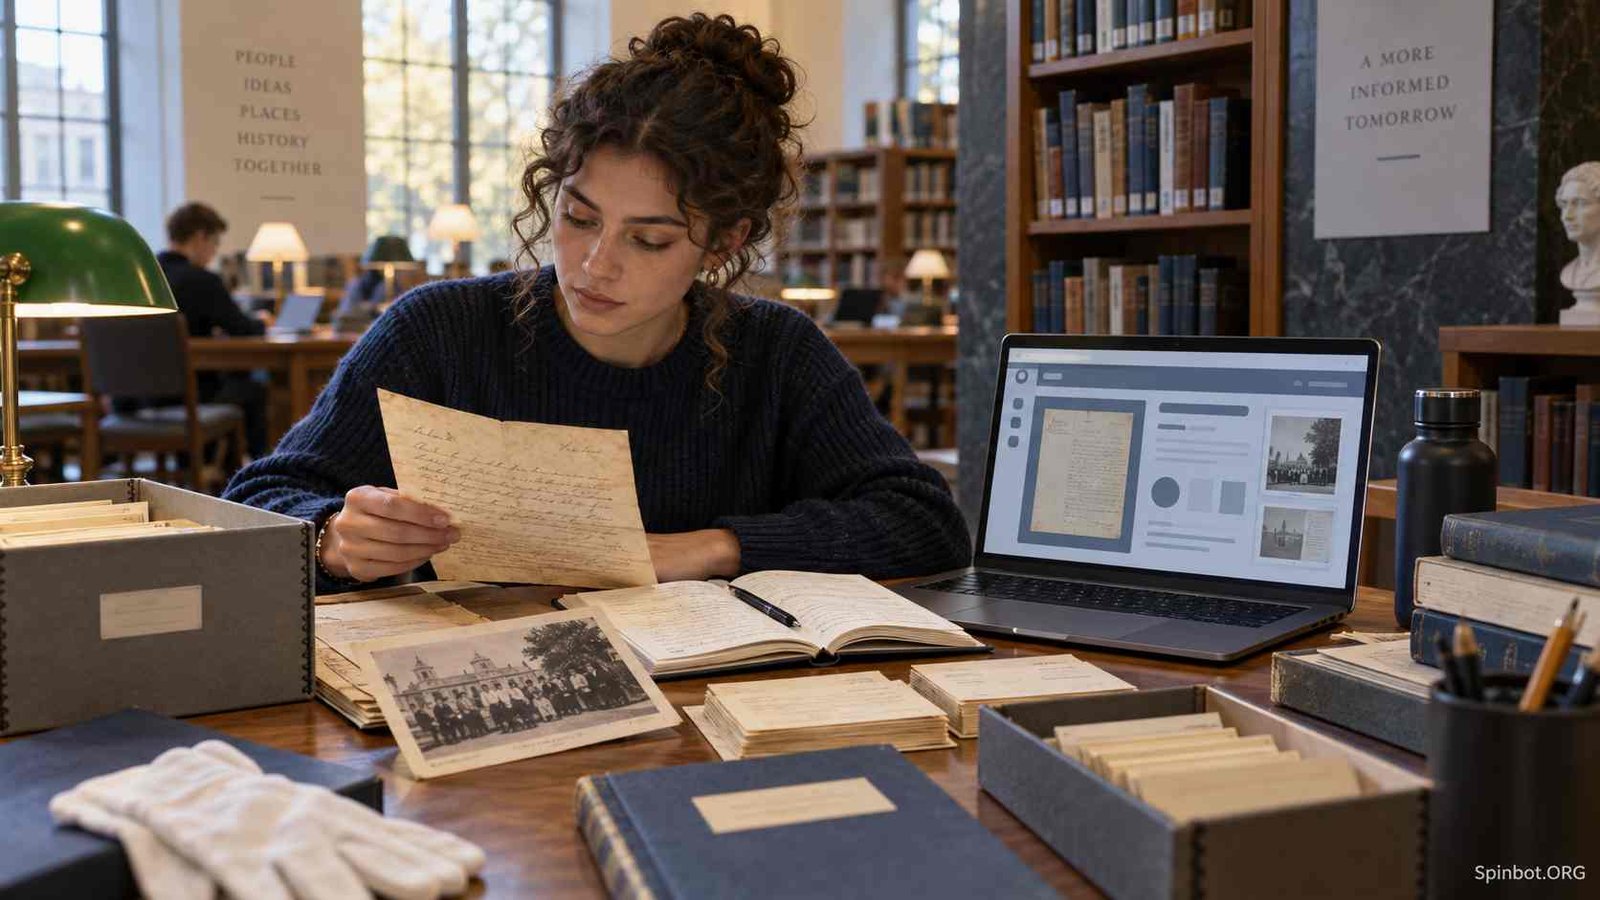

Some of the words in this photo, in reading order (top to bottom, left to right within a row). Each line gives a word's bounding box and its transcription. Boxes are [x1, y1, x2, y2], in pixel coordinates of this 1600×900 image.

[235, 50, 296, 69] PEOPLE
[1360, 55, 1371, 69] A
[1380, 45, 1434, 67] MORE
[244, 78, 292, 95] IDEAS
[1350, 74, 1449, 100] INFORMED
[239, 104, 301, 122] PLACES
[1344, 104, 1457, 130] TOMORROW
[237, 131, 308, 149] HISTORY
[234, 158, 322, 176] TOGETHER
